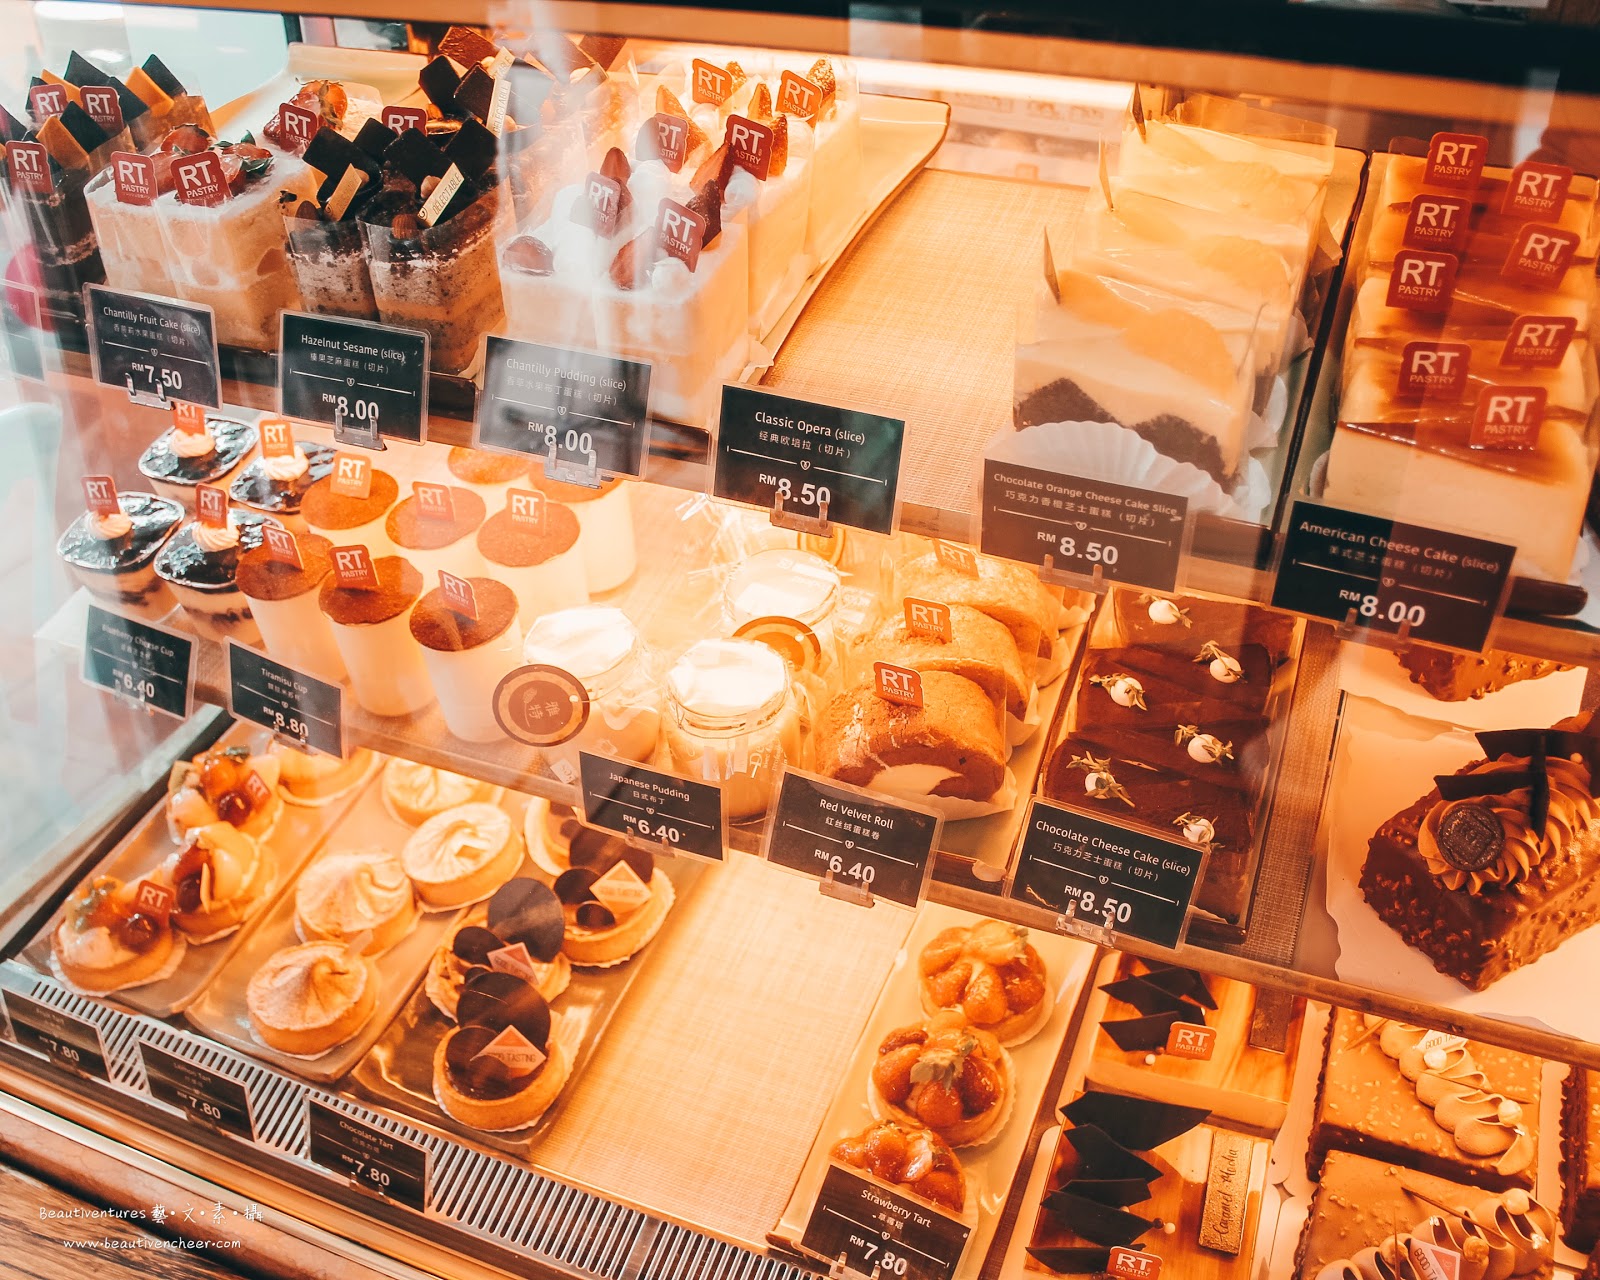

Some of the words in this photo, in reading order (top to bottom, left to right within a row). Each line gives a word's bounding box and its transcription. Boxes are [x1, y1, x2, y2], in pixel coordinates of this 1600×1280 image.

[698, 66, 726, 94] RT
[36, 91, 62, 114] RT
[85, 93, 111, 115] RT
[697, 86, 726, 103] PASTRY
[784, 79, 815, 108] RT
[284, 112, 311, 138] RT
[657, 122, 682, 148] RT
[731, 124, 765, 154] RT
[12, 149, 40, 172] RT
[661, 147, 678, 160] STRY
[735, 150, 762, 165] ASTRY
[1436, 142, 1478, 166] RT
[16, 171, 44, 180] PASTRY
[118, 160, 147, 185] RT
[178, 160, 212, 190] RT
[1434, 164, 1472, 176] PASTRY
[121, 183, 150, 194] PASTRY
[186, 184, 220, 198] PASTRY
[1518, 171, 1562, 198] RT
[588, 181, 613, 212] RT
[1514, 196, 1556, 208] PASTRY
[662, 210, 697, 243] RT
[1416, 202, 1460, 228] RT
[660, 232, 692, 254] PASTRY
[1414, 226, 1454, 238] PASTRY
[1522, 233, 1570, 263] RT
[1400, 258, 1446, 287] RT
[1518, 257, 1560, 274] PASTRY
[1398, 285, 1441, 298] PASTRY
[103, 306, 138, 323] Chantilly
[140, 314, 158, 326] Fruit
[160, 318, 178, 330] Cake
[180, 322, 200, 336] (slice)
[1516, 324, 1566, 347] RT
[301, 334, 340, 350] Hazelnut
[343, 342, 378, 356] Sesame
[380, 349, 406, 362] (slice)
[1411, 350, 1460, 374] RT
[132, 362, 144, 372] RM
[144, 364, 182, 390] 750
[506, 358, 551, 378] Chantilly
[554, 368, 596, 386] Pudding
[600, 377, 626, 392] (slice)
[1409, 374, 1456, 384] PASTRY
[322, 393, 336, 404] RM
[338, 396, 380, 420] 8.00
[1486, 396, 1536, 424] RT
[264, 424, 287, 444] RT
[528, 422, 544, 434] RM
[544, 425, 592, 454] 8.00
[755, 412, 794, 430] Classic
[797, 420, 832, 437] Opera
[834, 428, 866, 446] (slice)
[1483, 424, 1529, 434] PASTRY
[338, 458, 366, 479] RT
[86, 480, 108, 499] RT
[200, 489, 221, 510] RT
[418, 486, 444, 506] RT
[759, 474, 776, 486] RM
[778, 478, 831, 507] 8.50
[994, 473, 1044, 490] Chocolate
[1046, 484, 1083, 499] Orange
[1085, 491, 1122, 506] Cheese
[1124, 499, 1150, 511] Cake
[1152, 504, 1178, 516] Slice
[512, 494, 539, 516] RT
[266, 530, 289, 550] RT
[1036, 532, 1056, 543] RM
[1060, 536, 1118, 565] 8.50
[1300, 520, 1366, 544] American
[1369, 536, 1421, 557] Cheese
[1424, 546, 1458, 564] Cake
[1461, 555, 1500, 574] (slice)
[336, 550, 363, 570] RT
[939, 544, 968, 564] RT
[340, 569, 368, 578] PASTRY
[443, 574, 466, 598] RT
[911, 604, 942, 625] RT
[1338, 589, 1361, 602] RM
[1360, 595, 1426, 627] 8.00
[912, 620, 944, 633] PASTRY
[160, 646, 175, 658] Cup
[124, 674, 154, 698] 6.40
[261, 668, 292, 688] Tiramisu
[293, 682, 308, 694] Cup
[880, 668, 912, 691] RT
[882, 686, 915, 699] PASTRY
[262, 706, 274, 716] RM
[275, 712, 308, 738] 8.80
[247, 775, 267, 798] RT
[609, 772, 650, 790] Japanese
[652, 784, 690, 802] Pudding
[632, 790, 666, 805] 日式布丁
[820, 798, 838, 812] Red
[840, 804, 872, 824] Velvet
[874, 815, 894, 830] Roll
[622, 814, 637, 824] RM
[638, 820, 680, 842] 6.40
[1036, 820, 1089, 844] Chocolate
[1091, 837, 1131, 857] Cheese
[1133, 850, 1160, 866] Cake
[1162, 858, 1191, 877] (slice)
[814, 848, 830, 861] RM
[829, 855, 876, 884] 6.40
[1052, 842, 1160, 882] 巧克力芝士蛋糕（切片）
[140, 885, 168, 908] RT
[1064, 884, 1082, 898] RM
[1079, 891, 1132, 923] 8.50
[1175, 1042, 1207, 1054] PASTRY
[1176, 1029, 1210, 1046] RT
[188, 1096, 221, 1119] 7.80
[354, 1160, 390, 1186] 7.80
[860, 1189, 912, 1220] Strawberry
[913, 1212, 932, 1228] Tart
[850, 1234, 866, 1248] RM
[864, 1242, 908, 1276] 7.80
[1116, 1253, 1154, 1272] RT
[1414, 1248, 1430, 1270] GOOD
[1116, 1264, 1151, 1277] PASTRY
